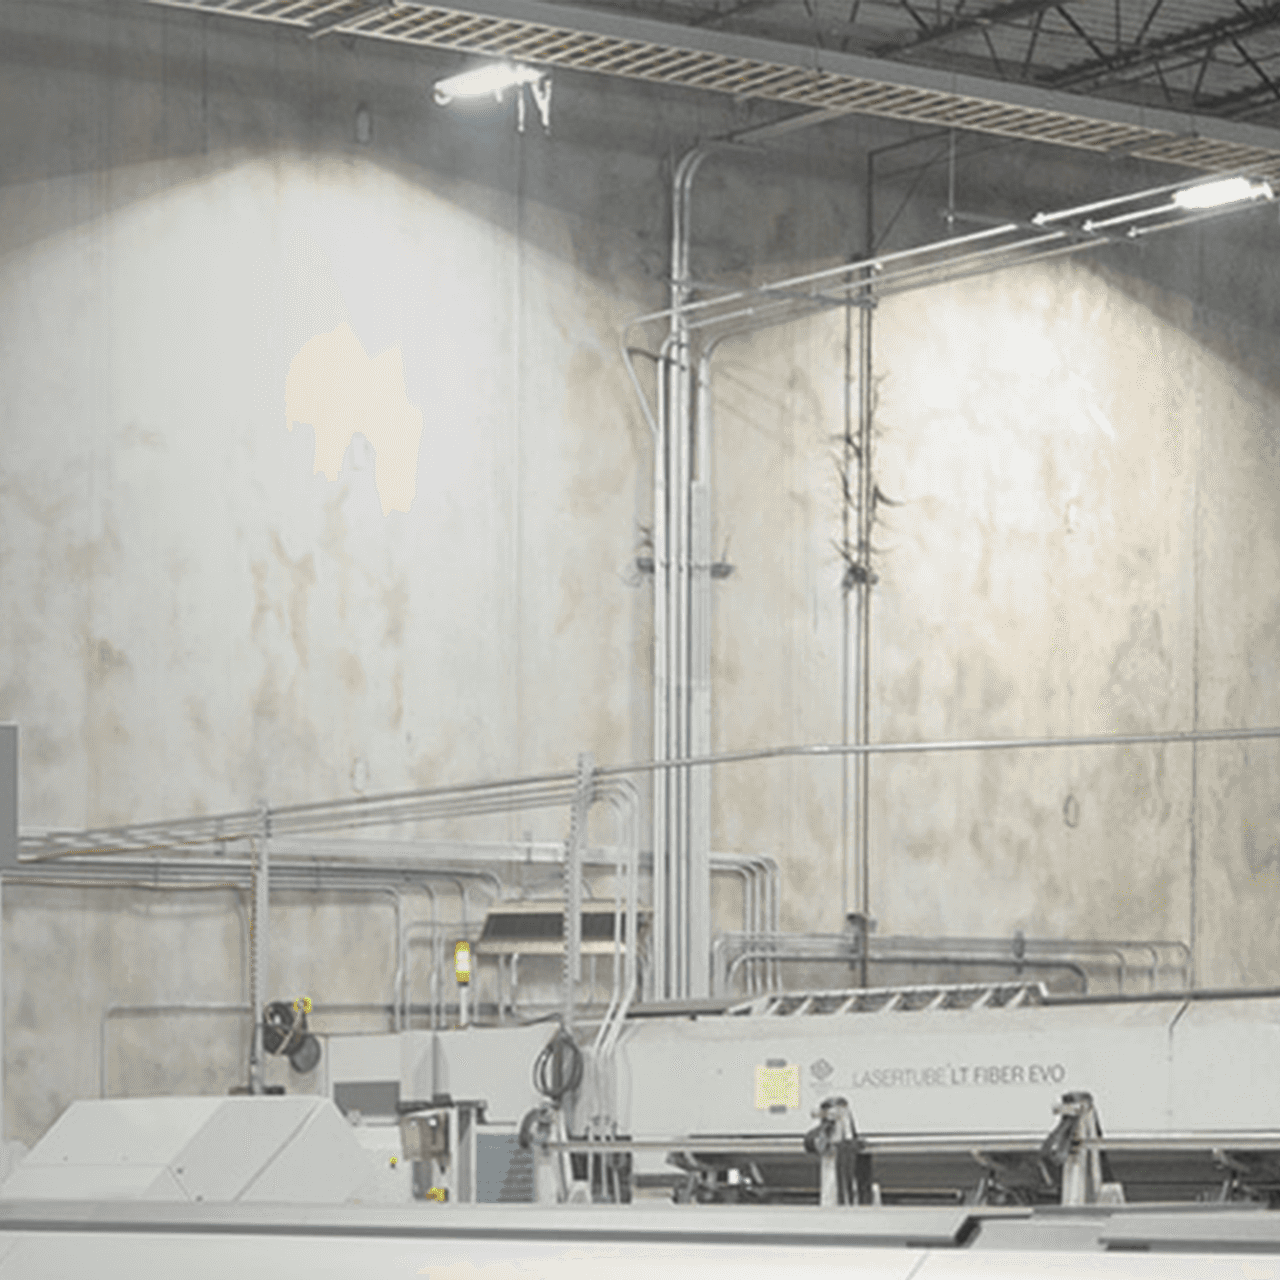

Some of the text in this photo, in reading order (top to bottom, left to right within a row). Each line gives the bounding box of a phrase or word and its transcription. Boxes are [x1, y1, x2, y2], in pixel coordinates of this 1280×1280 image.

[851, 1062, 1066, 1088] LASERTUBE LT FIBER EVO
